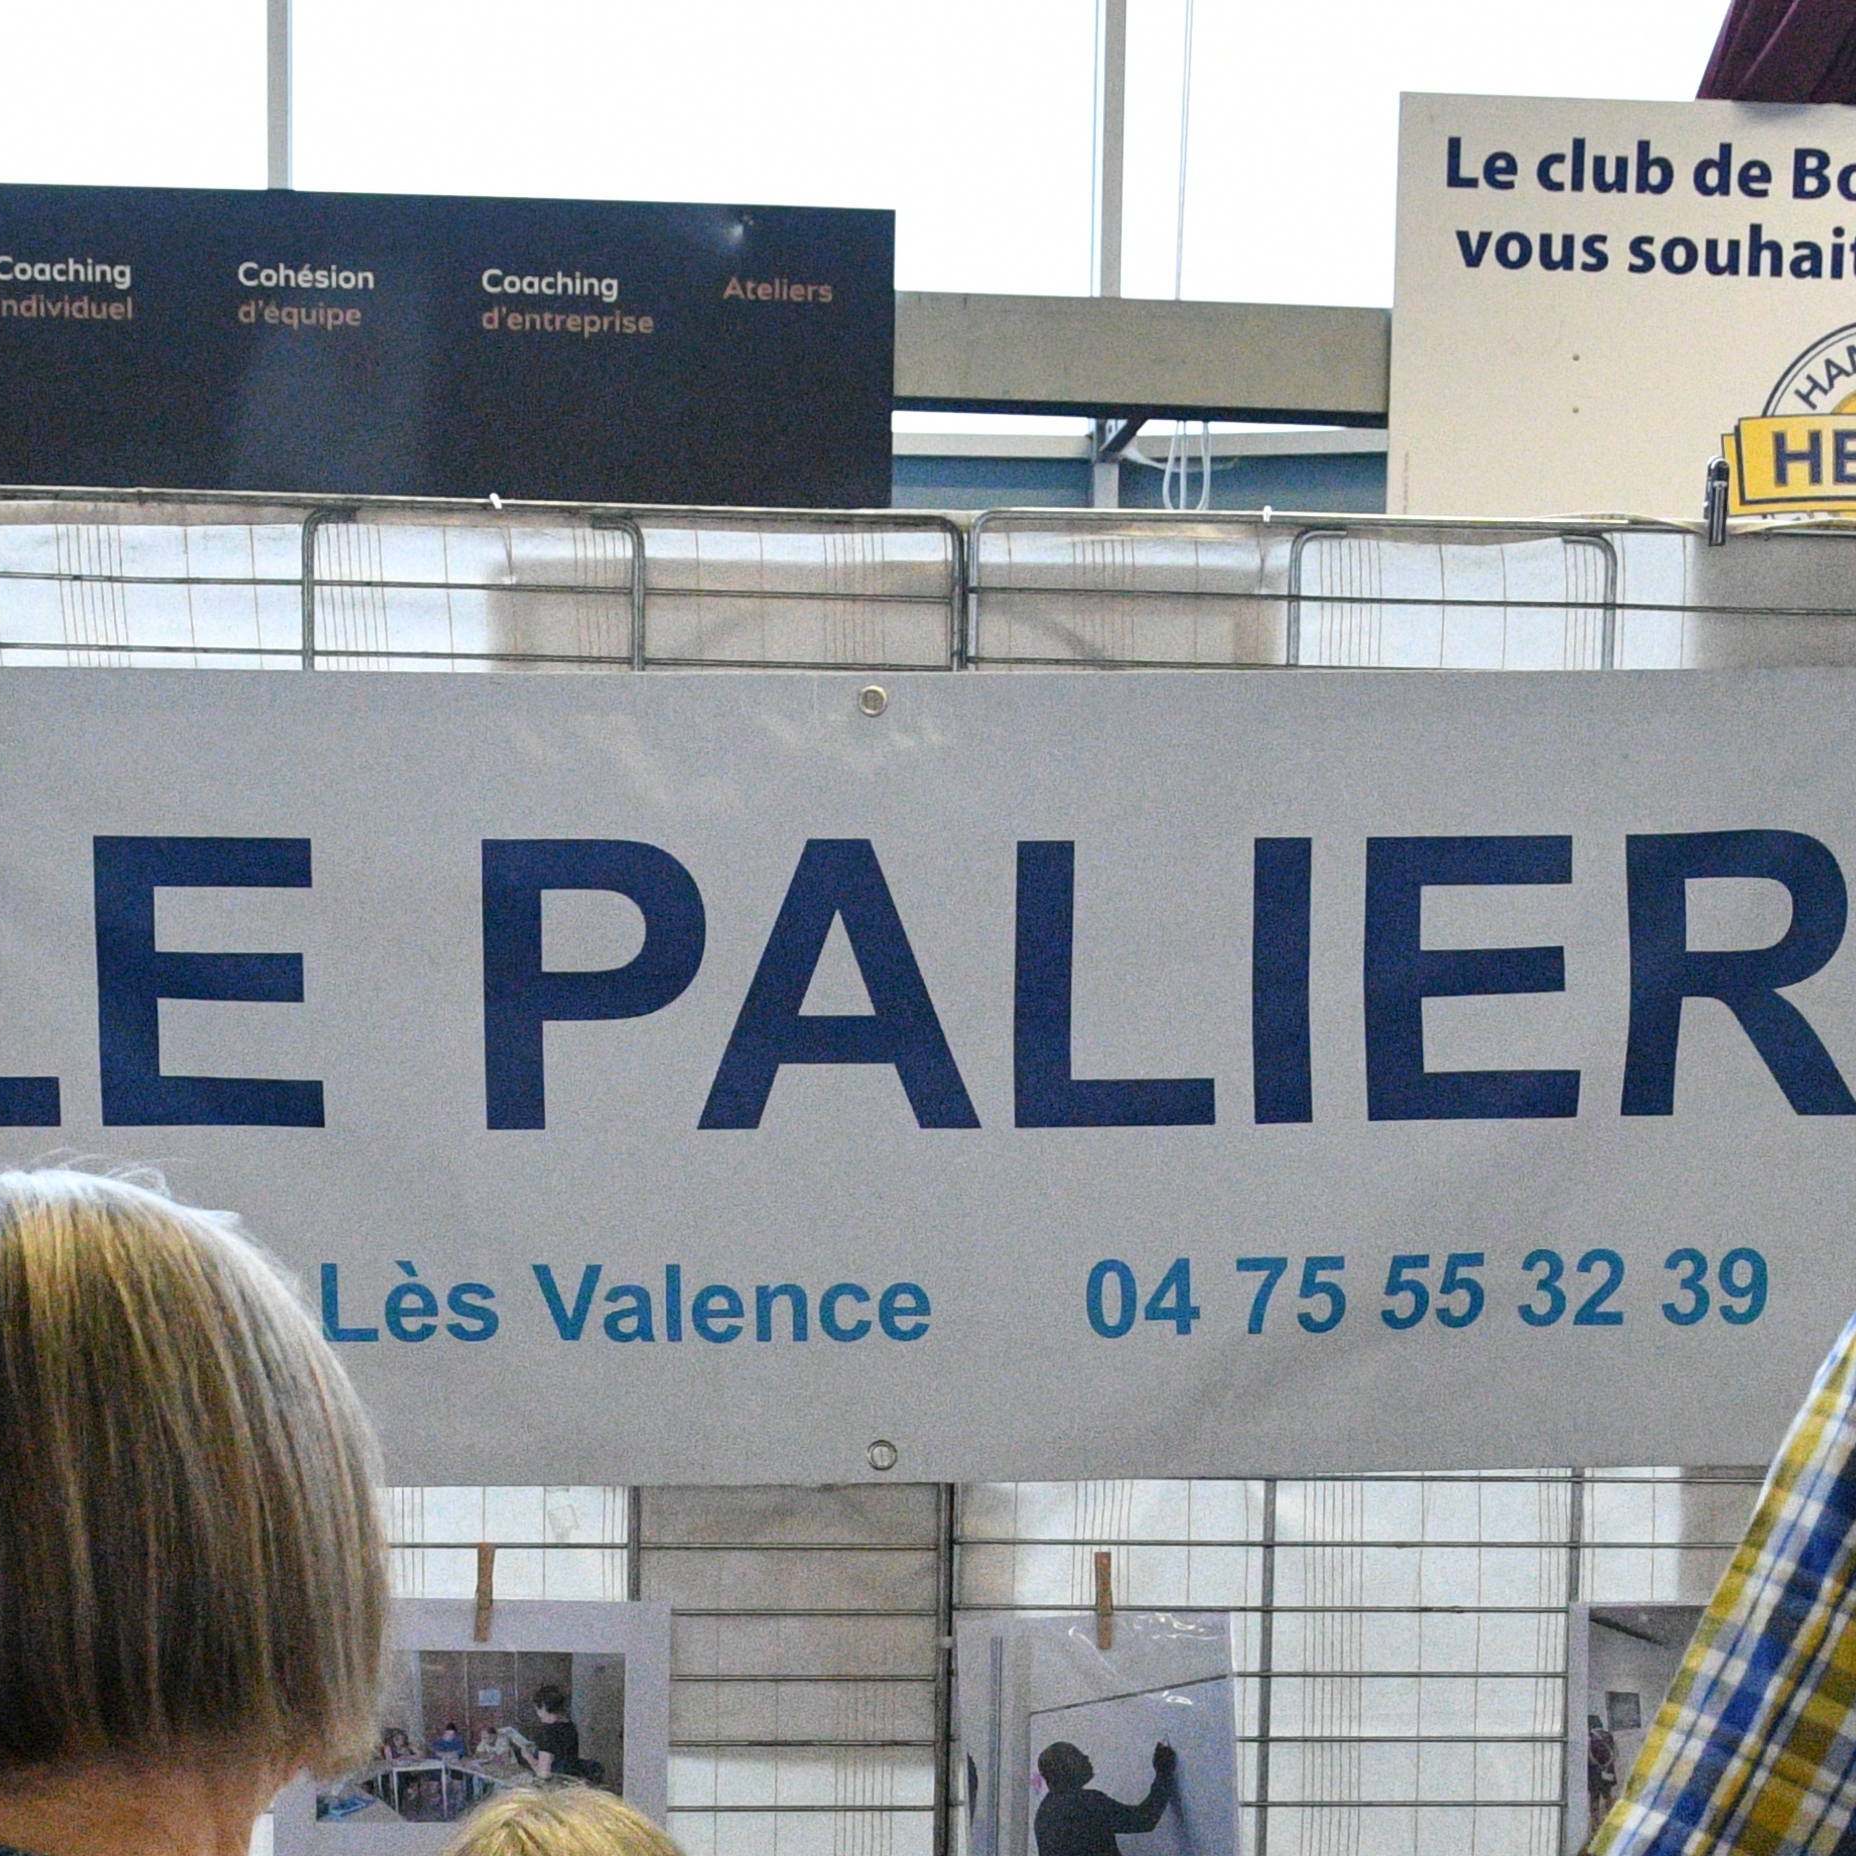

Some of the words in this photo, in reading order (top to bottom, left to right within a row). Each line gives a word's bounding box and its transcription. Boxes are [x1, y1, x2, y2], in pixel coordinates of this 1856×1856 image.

[1446, 136, 1519, 190] Le
[1535, 137, 1675, 196] club
[1692, 142, 1773, 198] de
[1455, 230, 1610, 272] vous
[237, 261, 375, 291] Cohésion
[480, 268, 619, 302] Coaching
[722, 276, 833, 303] Ateliers
[237, 301, 362, 331] d'équipe
[481, 306, 654, 340] d'entreprise
[319, 1259, 500, 1344] Lès
[531, 1263, 933, 1344] Valence
[1085, 1256, 1201, 1339] 04
[1235, 1255, 1348, 1336] 75
[1379, 1252, 1486, 1330] 55
[1516, 1248, 1625, 1328] 32
[1660, 1246, 1769, 1326] 39
